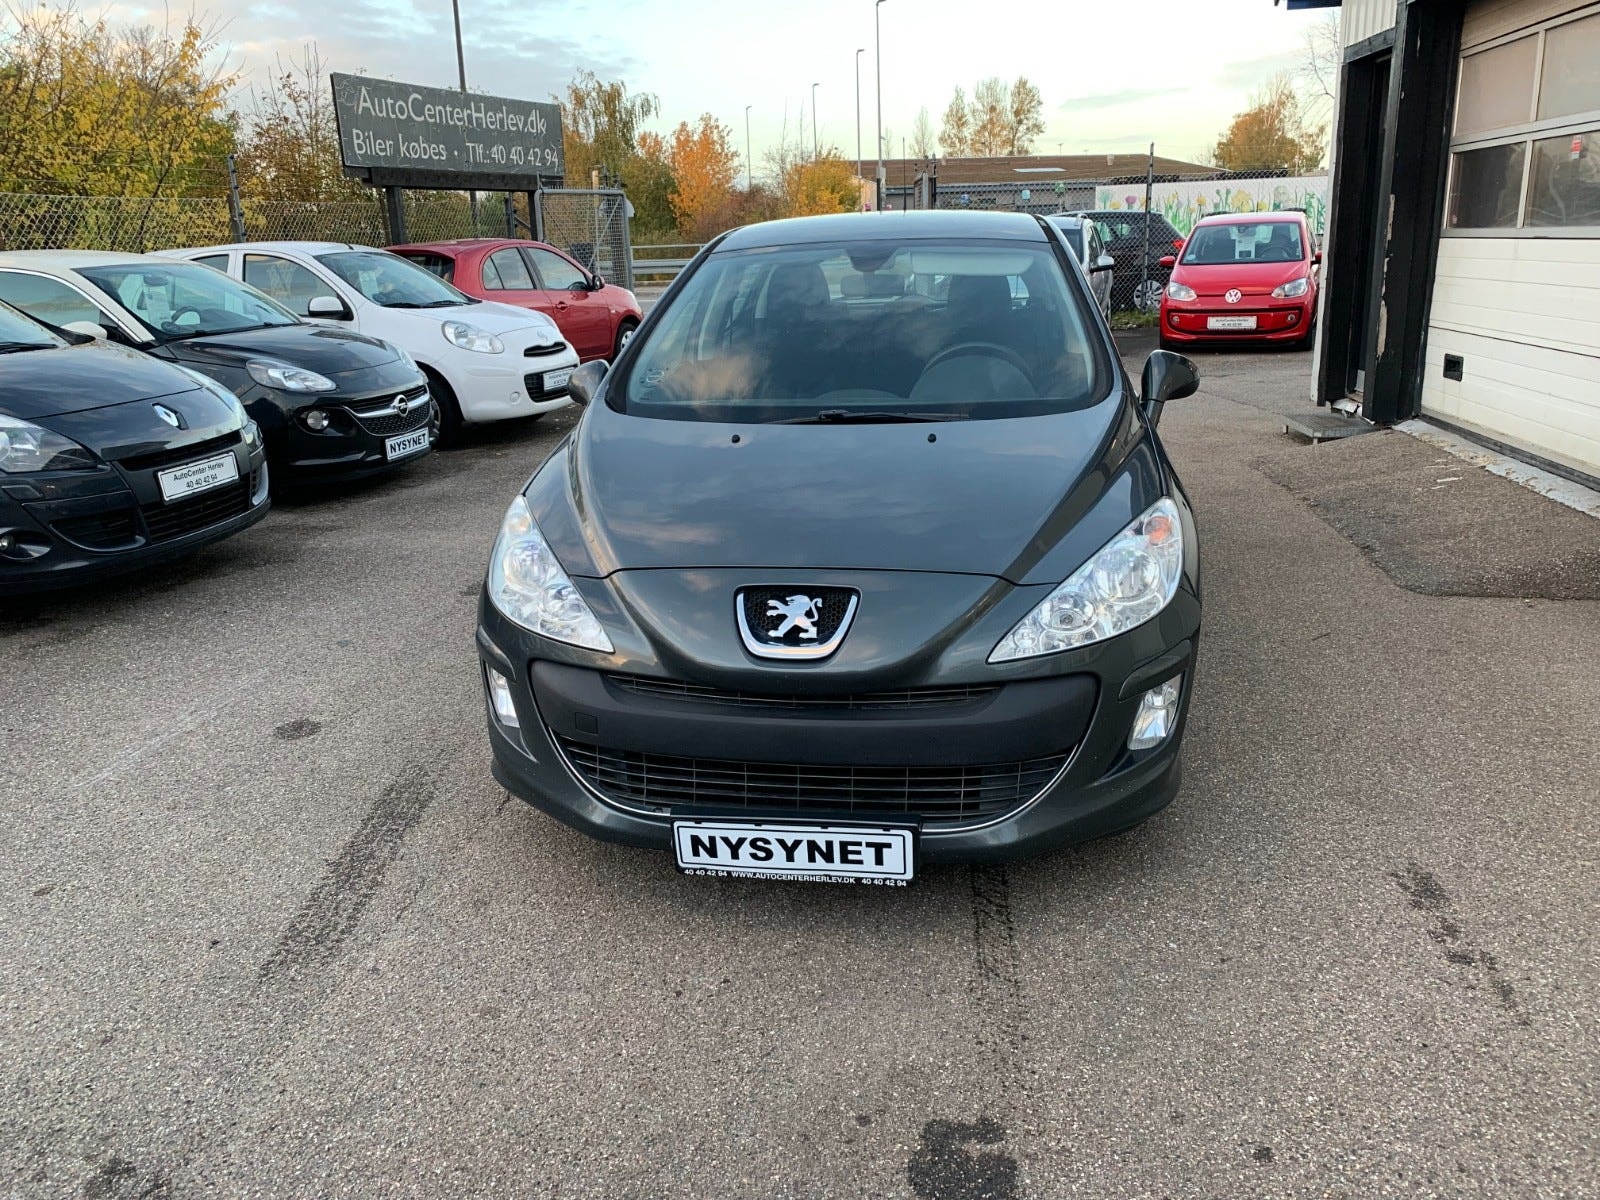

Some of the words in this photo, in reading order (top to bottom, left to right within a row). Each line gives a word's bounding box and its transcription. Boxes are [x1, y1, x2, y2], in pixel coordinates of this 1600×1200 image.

[358, 86, 547, 134] AutoCenterHerlev.dk
[398, 133, 447, 160] købes
[509, 146, 524, 165] 40
[527, 148, 542, 166] 42
[544, 148, 559, 167] 94
[390, 433, 426, 454] NYSYNET
[173, 466, 207, 481] AutoCenter
[690, 834, 892, 866] NYSYNET
[731, 871, 856, 884] WWW.AUTOCENTERHERLEV.DK
[873, 878, 884, 886] 40
